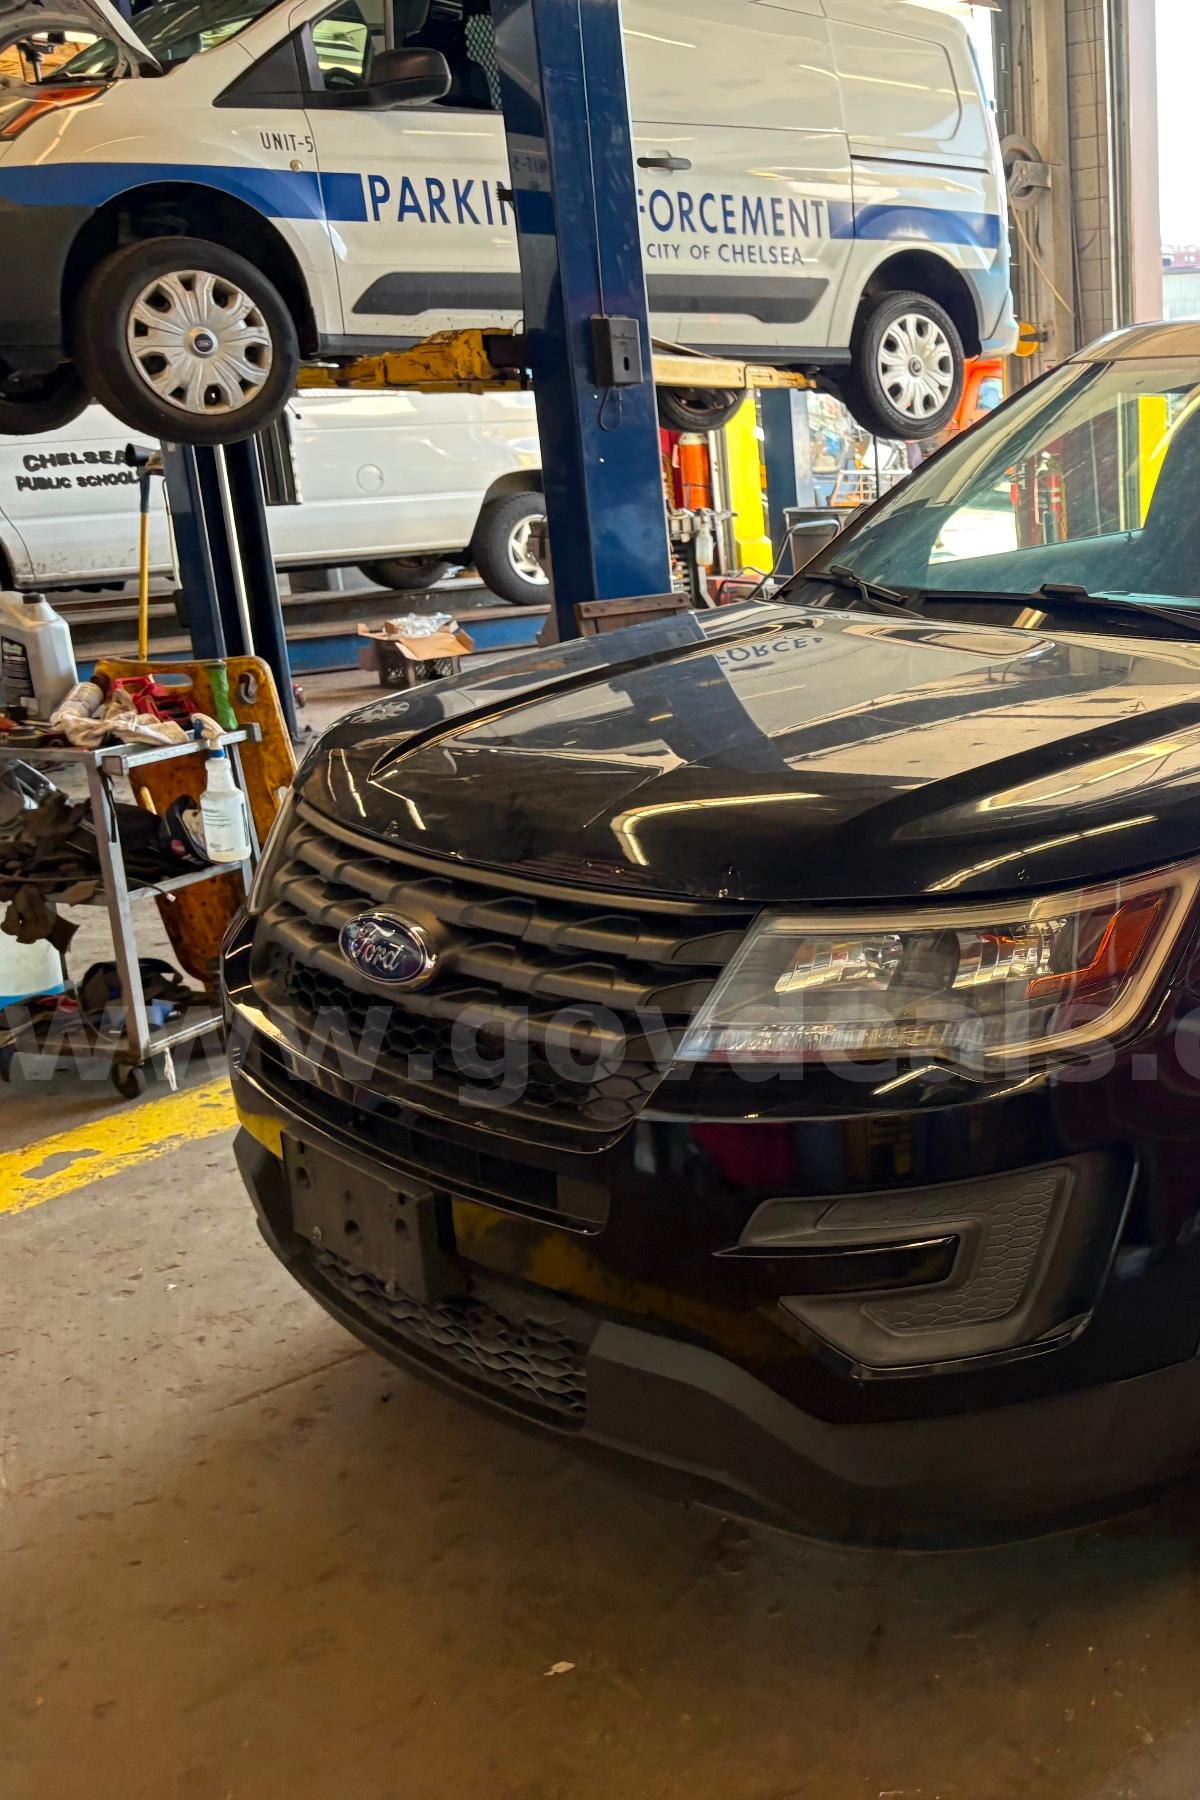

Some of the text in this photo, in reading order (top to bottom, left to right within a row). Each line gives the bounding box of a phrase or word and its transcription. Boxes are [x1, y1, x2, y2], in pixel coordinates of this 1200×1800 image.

[260, 132, 314, 153] UNIT-5
[646, 243, 804, 265] CITY OF CHELSEA
[22, 450, 134, 472] CHELSEA
[15, 476, 72, 492] PUBLIC
[351, 921, 404, 970] Ford
